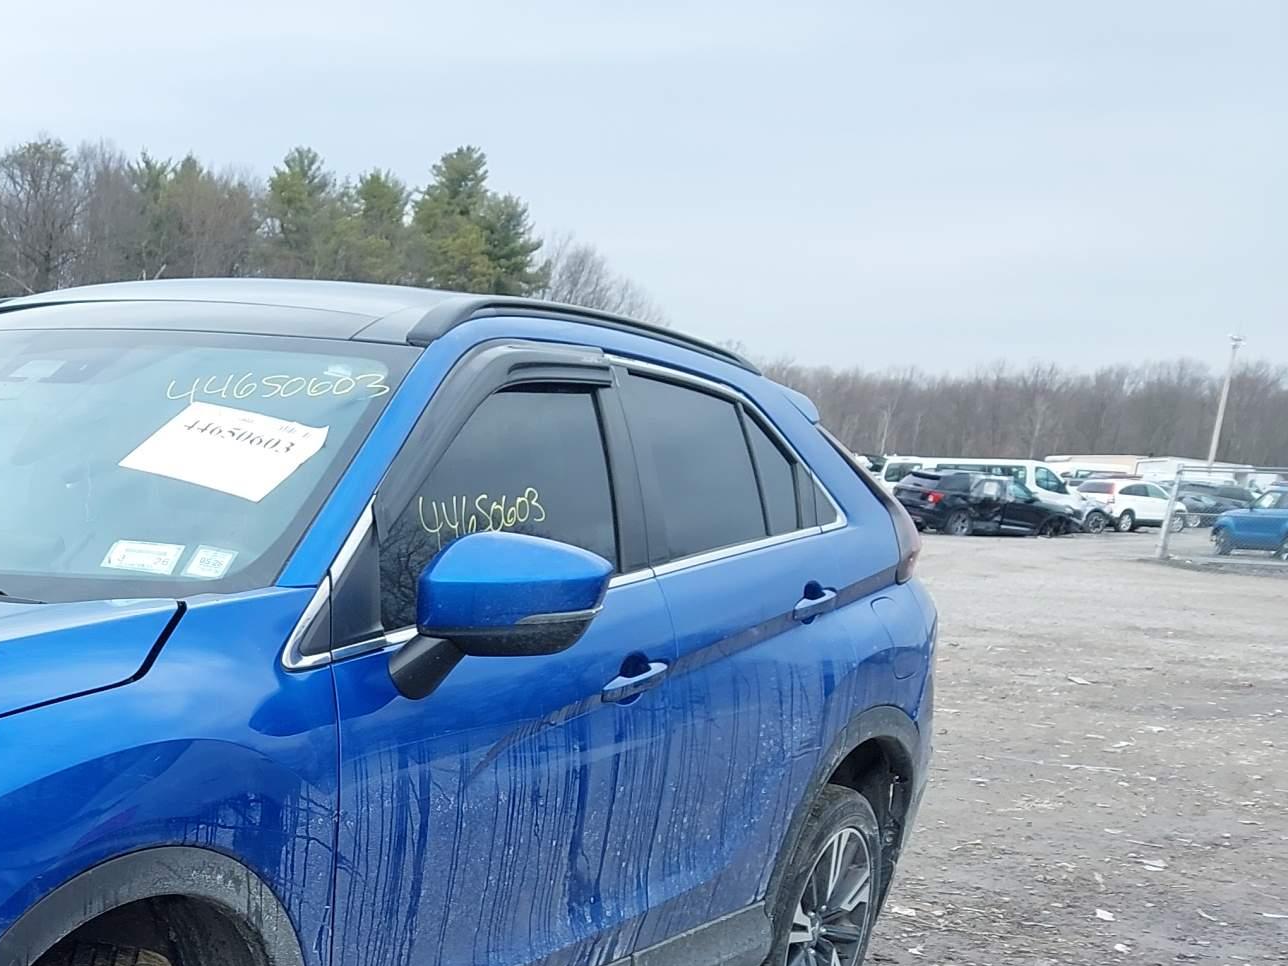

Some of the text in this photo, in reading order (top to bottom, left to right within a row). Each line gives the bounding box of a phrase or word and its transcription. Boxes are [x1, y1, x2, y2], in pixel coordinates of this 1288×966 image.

[167, 372, 390, 404] 44650603
[184, 419, 296, 453] 44650603
[418, 487, 546, 551] 44650603
